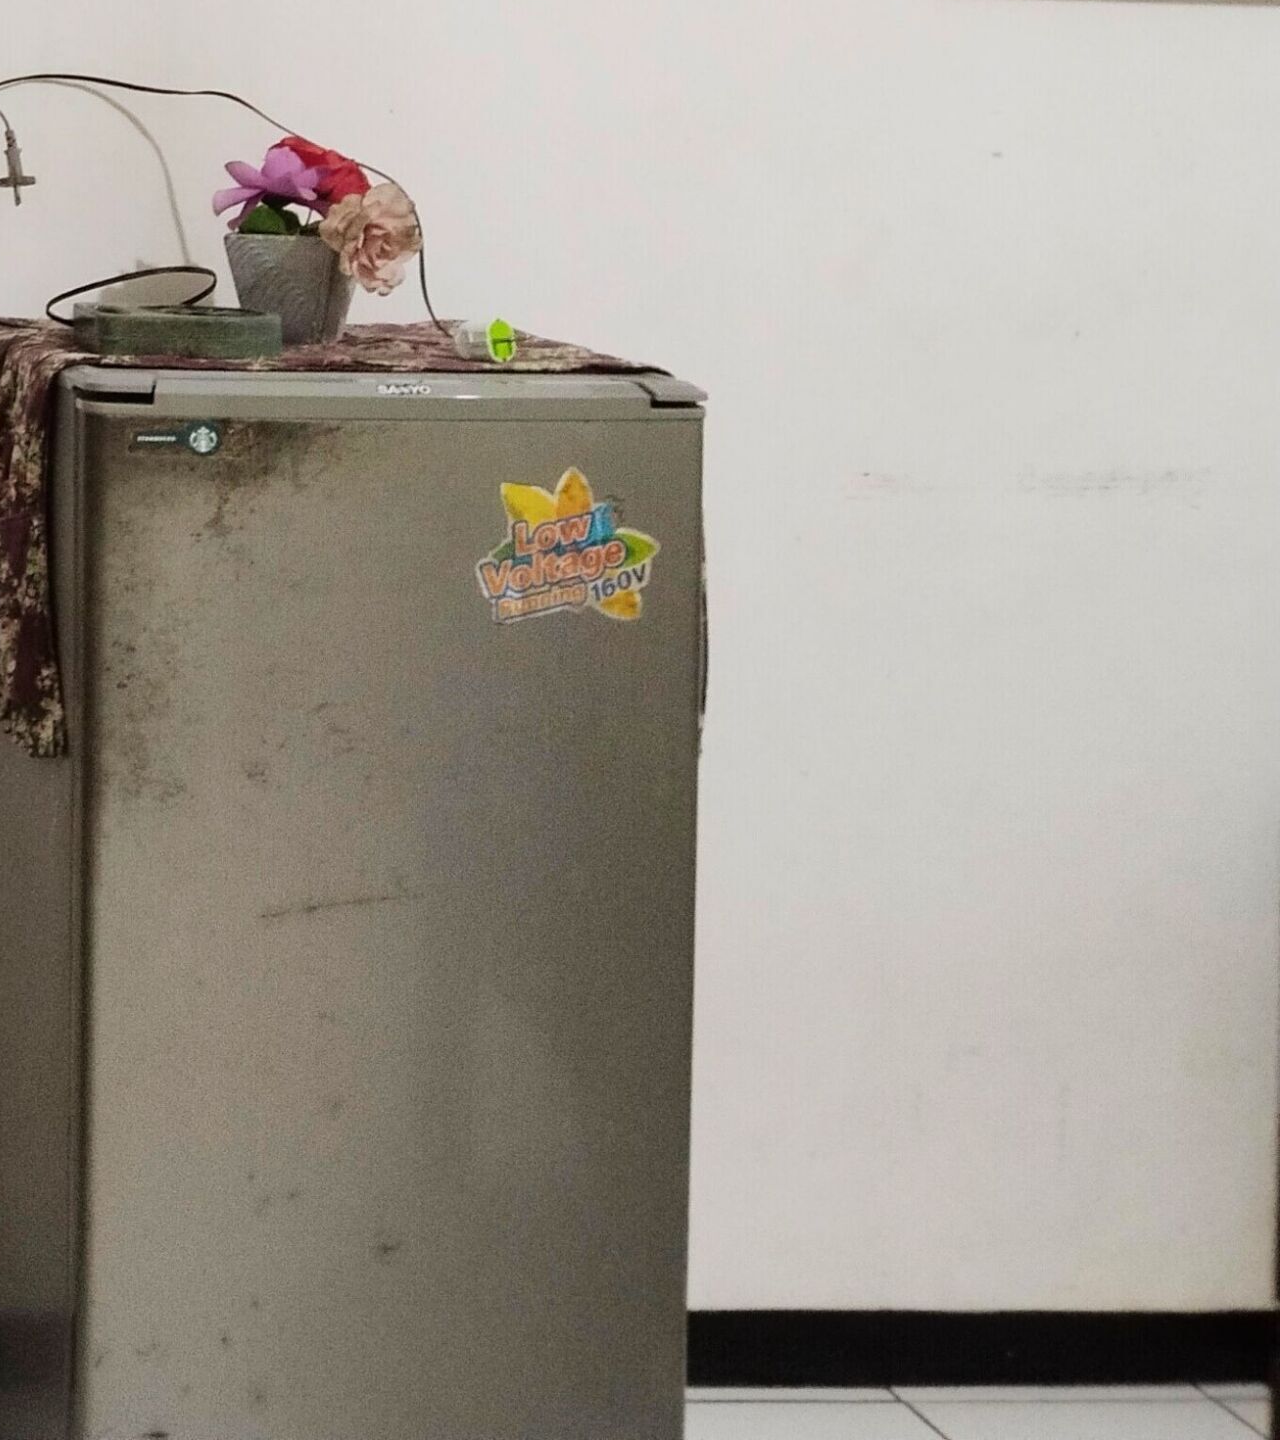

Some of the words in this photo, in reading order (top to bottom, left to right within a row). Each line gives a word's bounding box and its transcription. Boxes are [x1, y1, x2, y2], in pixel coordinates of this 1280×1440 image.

[514, 513, 592, 555] Low
[481, 540, 627, 597] Voltage
[591, 564, 647, 601] 160V
